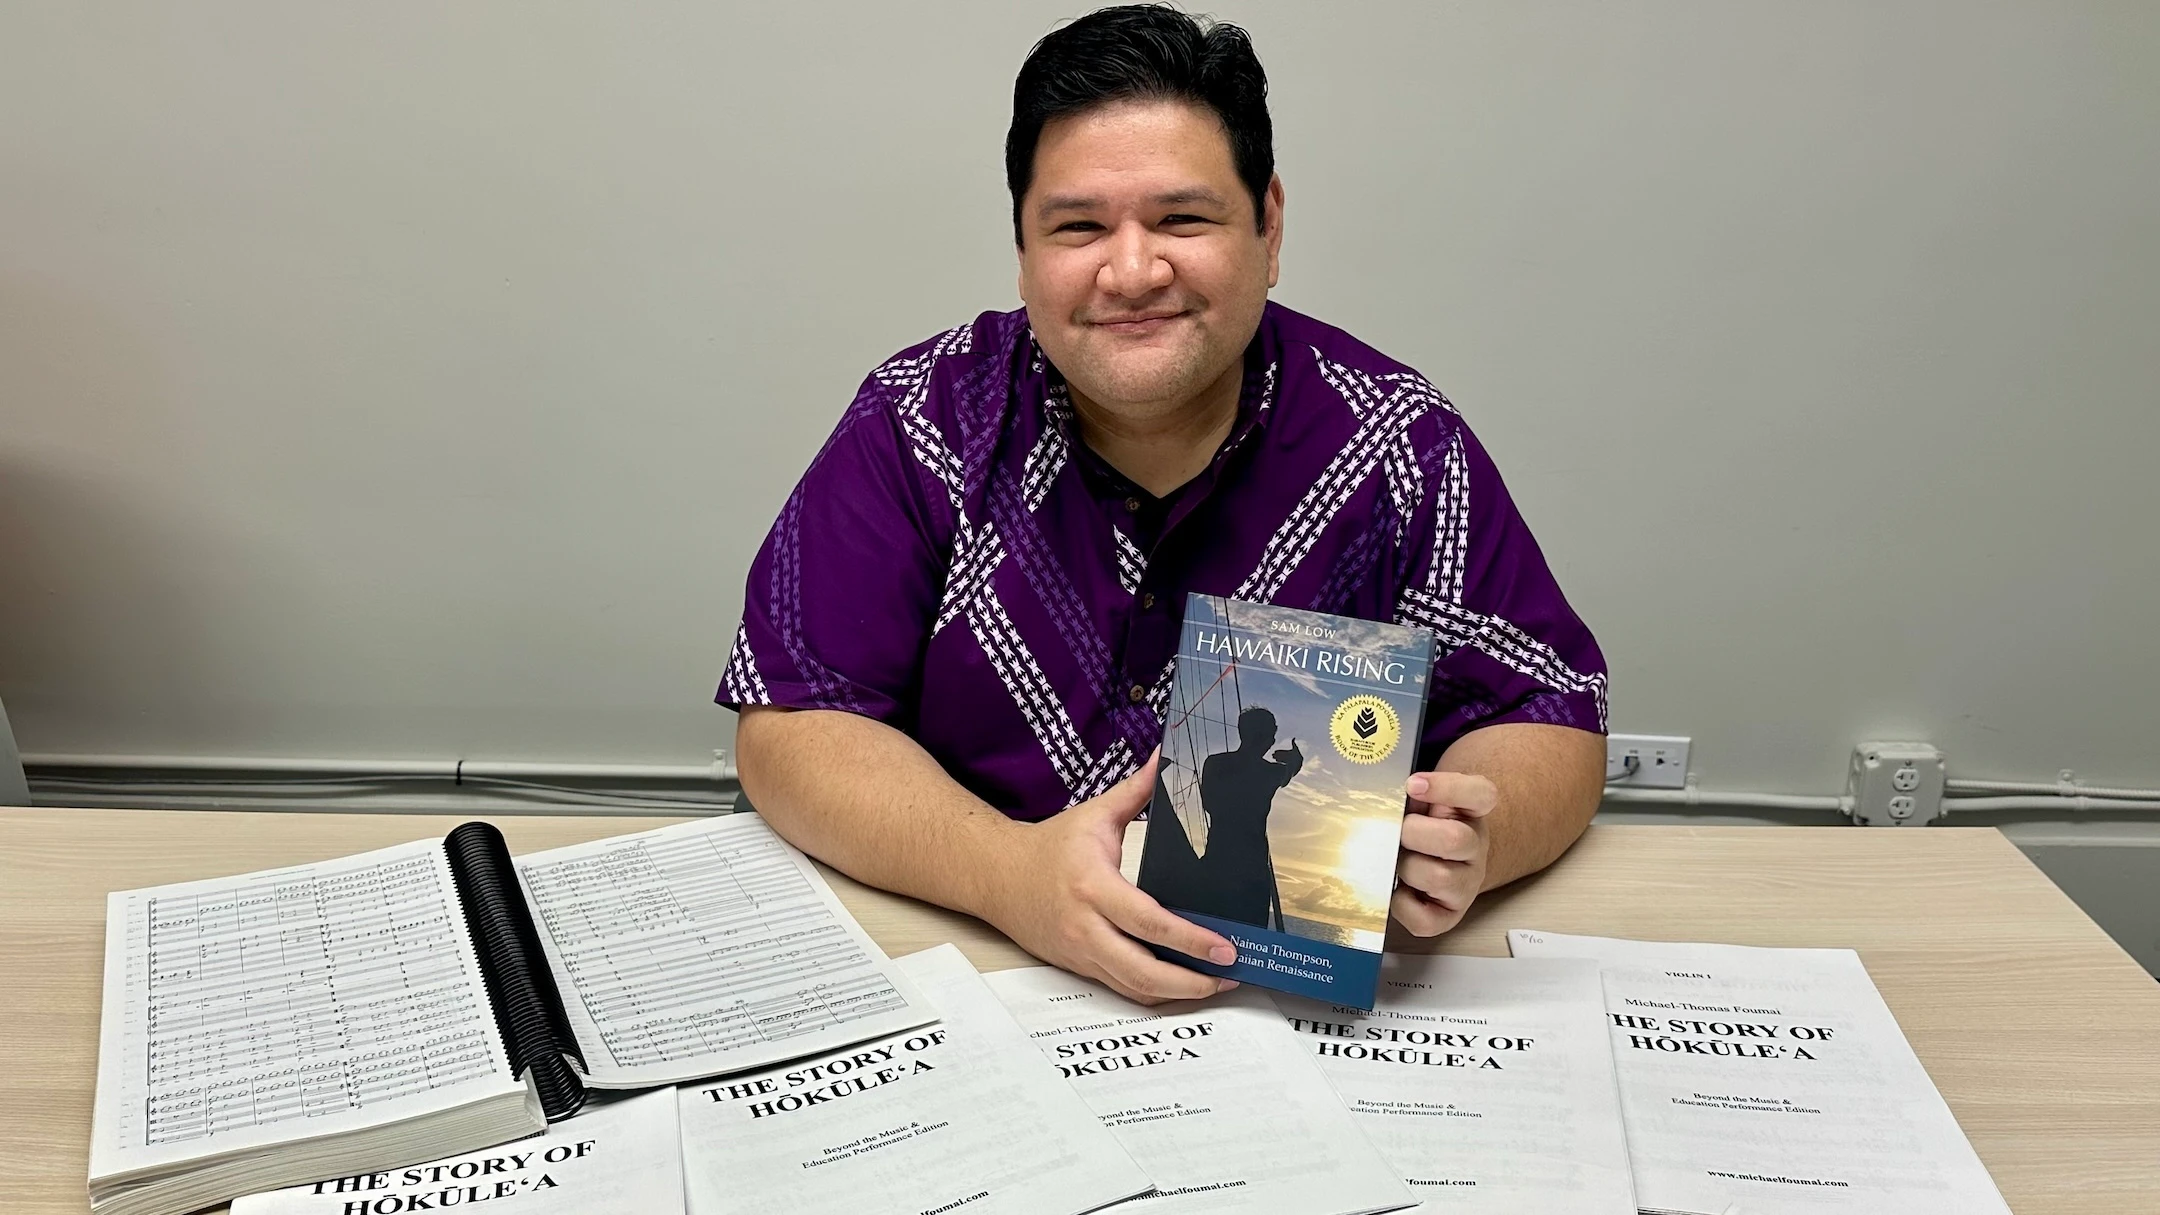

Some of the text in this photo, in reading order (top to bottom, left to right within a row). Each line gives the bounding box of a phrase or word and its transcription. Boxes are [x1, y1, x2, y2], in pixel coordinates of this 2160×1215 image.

[1270, 620, 1337, 639] SAM LOW
[1196, 631, 1406, 685] HAWAIKI RISING
[1336, 711, 1345, 721] KA
[1343, 699, 1376, 713] PALAPALA
[1335, 734, 1348, 753] BOOK
[1348, 750, 1358, 759] OF
[1375, 742, 1391, 757] YEAR
[1230, 934, 1333, 969] Nainoa Thompson,
[1236, 954, 1334, 984] aiian Renaissance
[1664, 971, 1705, 979] VIOLIN
[1387, 980, 1427, 990] VIOLIN
[1048, 993, 1087, 1003] VIOLIN
[1624, 997, 1782, 1015] Michael-Thomas Foumai
[1029, 1013, 1163, 1039] chael-Thomas Foumai
[1332, 1006, 1488, 1026] Michael-Thomas Foumai
[1287, 1017, 1535, 1053] THE STORY OF
[1605, 1012, 1834, 1042] HE STORY OF
[1055, 1022, 1215, 1060] STORY OF
[702, 1028, 948, 1104] THE STORY OF
[1357, 1099, 1394, 1109] Beyond
[1396, 1100, 1412, 1108] the
[1671, 1097, 1821, 1114] Education Performance Edition
[1693, 1092, 1731, 1102] Beyond
[1732, 1095, 1748, 1103] the
[1749, 1097, 1780, 1105] Music
[1116, 1112, 1176, 1127] Performance
[1177, 1106, 1212, 1117] Edition
[1126, 1108, 1141, 1117] the
[1142, 1104, 1172, 1114] Music
[1382, 1108, 1444, 1116] Performance
[1446, 1110, 1483, 1118] Edition
[802, 1120, 949, 1170] Education Performance Edition
[823, 1121, 920, 1156] Beyond the Music &
[311, 1139, 596, 1195] THE STORY OF
[1706, 1170, 1849, 1187] www.michaelfoumai.com
